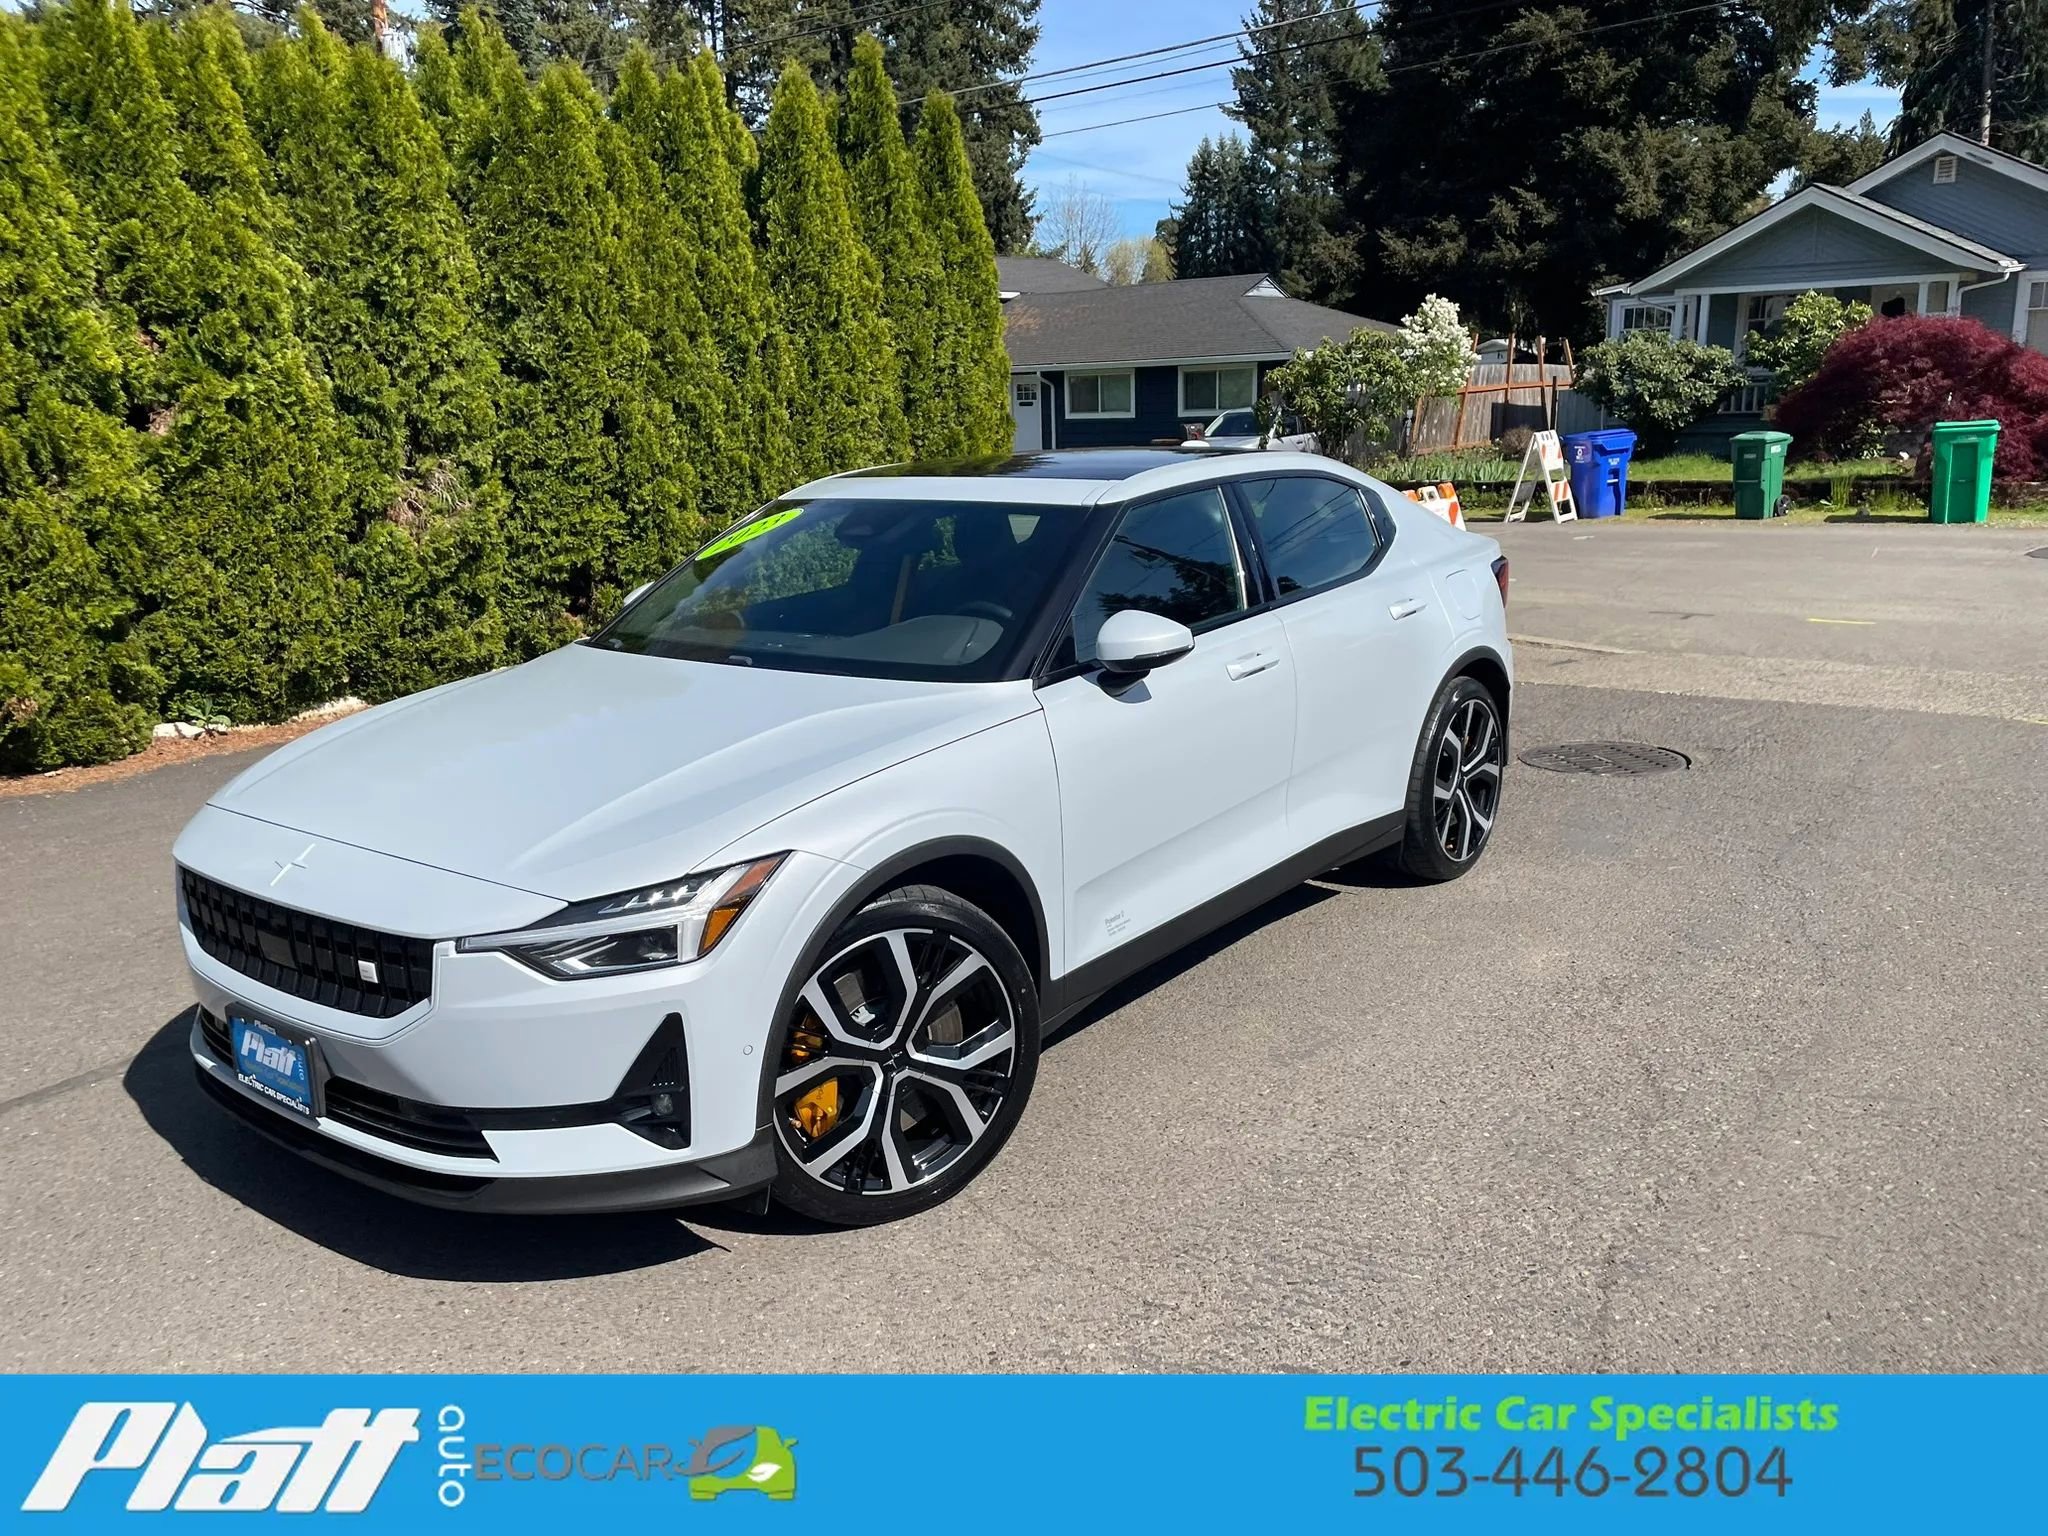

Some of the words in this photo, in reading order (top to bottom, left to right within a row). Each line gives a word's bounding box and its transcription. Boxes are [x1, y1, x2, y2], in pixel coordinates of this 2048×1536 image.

[240, 1029, 296, 1077] Platt
[238, 1073, 264, 1092] ELECTRIC
[264, 1086, 277, 1098] CAR
[276, 1092, 310, 1115] SPECIALISTS
